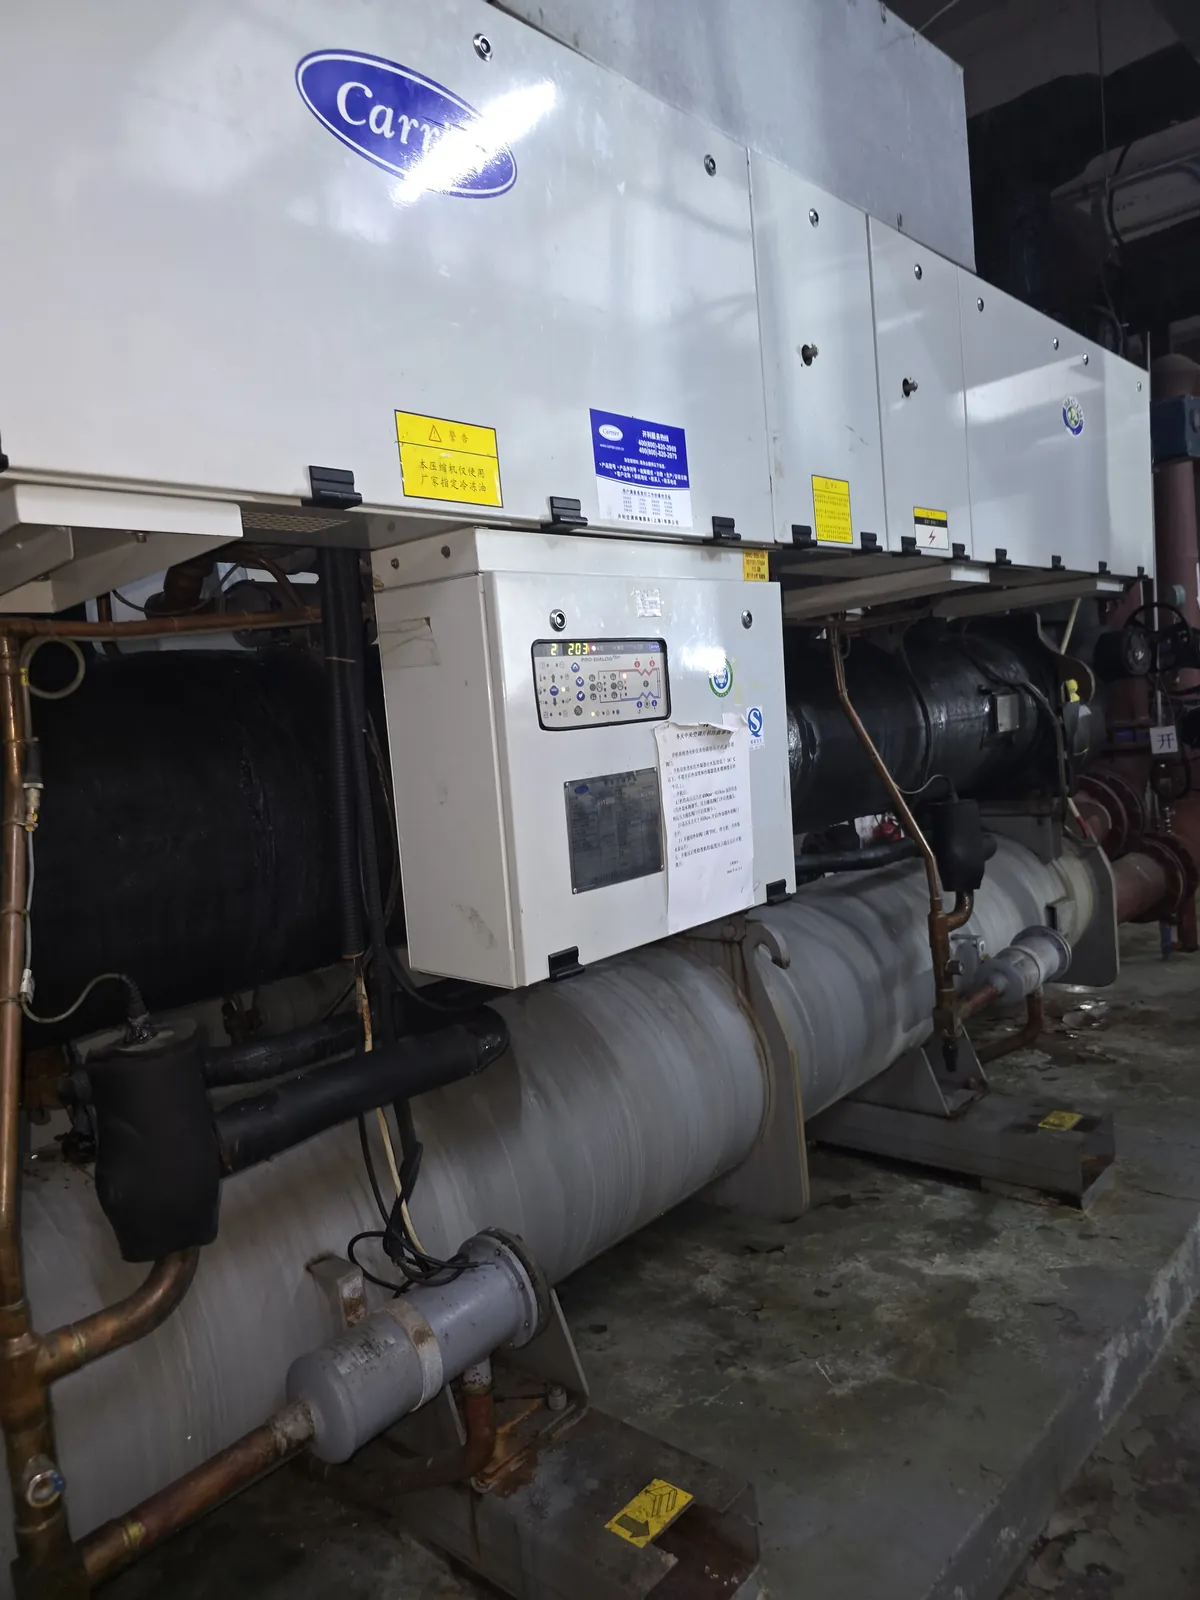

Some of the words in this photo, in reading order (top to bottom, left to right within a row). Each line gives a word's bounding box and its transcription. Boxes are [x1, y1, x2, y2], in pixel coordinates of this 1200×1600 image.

[420, 459, 485, 479] 本压缩机仅使用
[421, 475, 487, 492] 厂家指定冷冻油
[550, 643, 558, 656] 2
[568, 643, 588, 656] 203
[1157, 733, 1174, 749] 开
